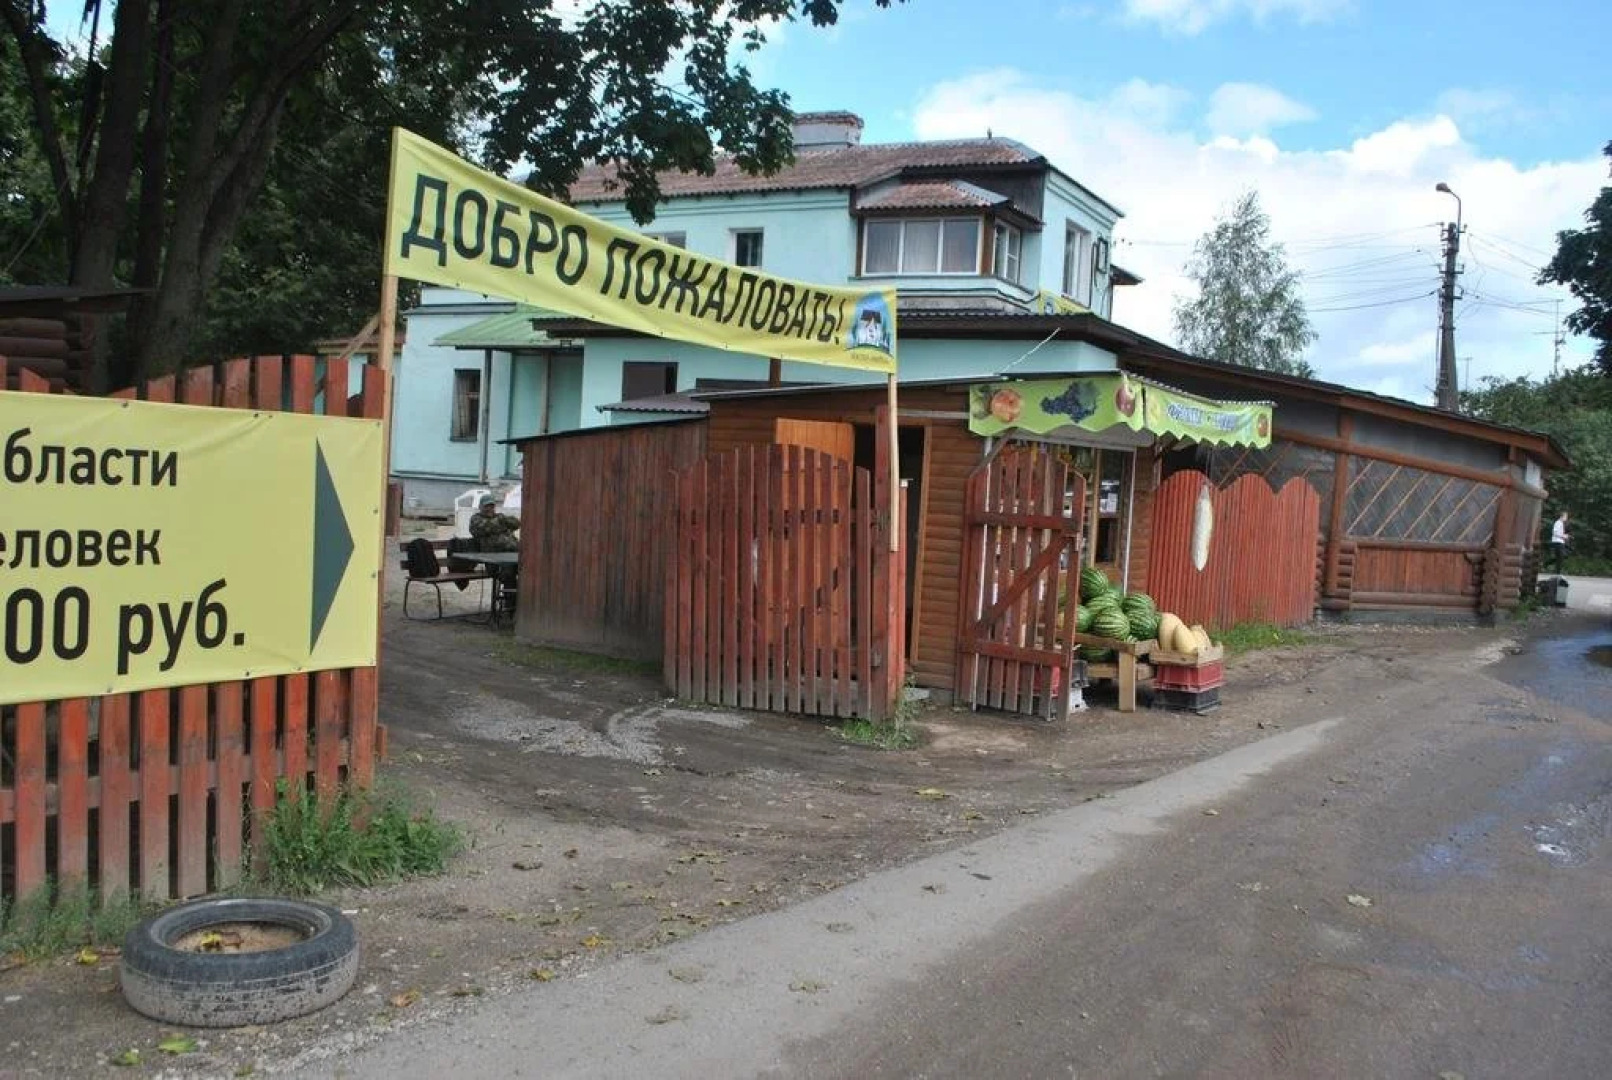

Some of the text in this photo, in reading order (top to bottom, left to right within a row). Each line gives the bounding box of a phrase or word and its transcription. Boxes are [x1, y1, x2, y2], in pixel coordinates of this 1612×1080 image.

[401, 174, 846, 345] ДОБРО ПОЖАЛОВАТЬ!
[5, 427, 178, 486] бласти
[5, 578, 246, 676] 00 руб.
